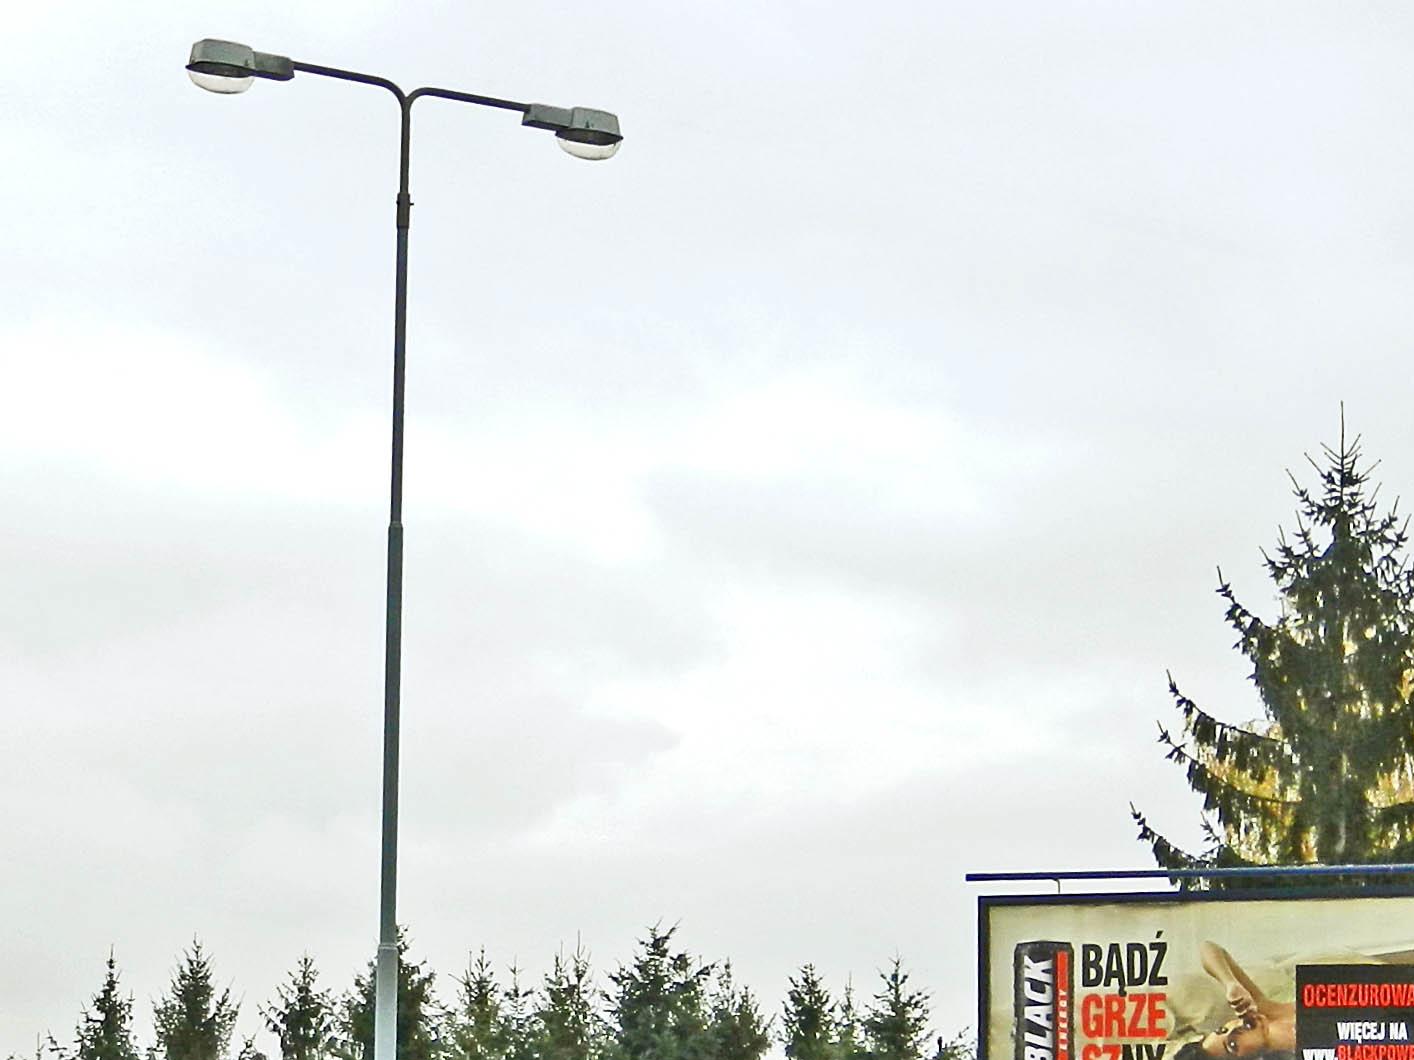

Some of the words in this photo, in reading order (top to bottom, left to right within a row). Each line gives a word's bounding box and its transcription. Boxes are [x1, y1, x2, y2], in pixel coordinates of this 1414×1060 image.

[1082, 931, 1168, 997] BĄDŹ
[1081, 993, 1168, 1039] GRZE
[1337, 1022, 1386, 1043] WIĘCEJ
[1389, 1022, 1408, 1040] NA
